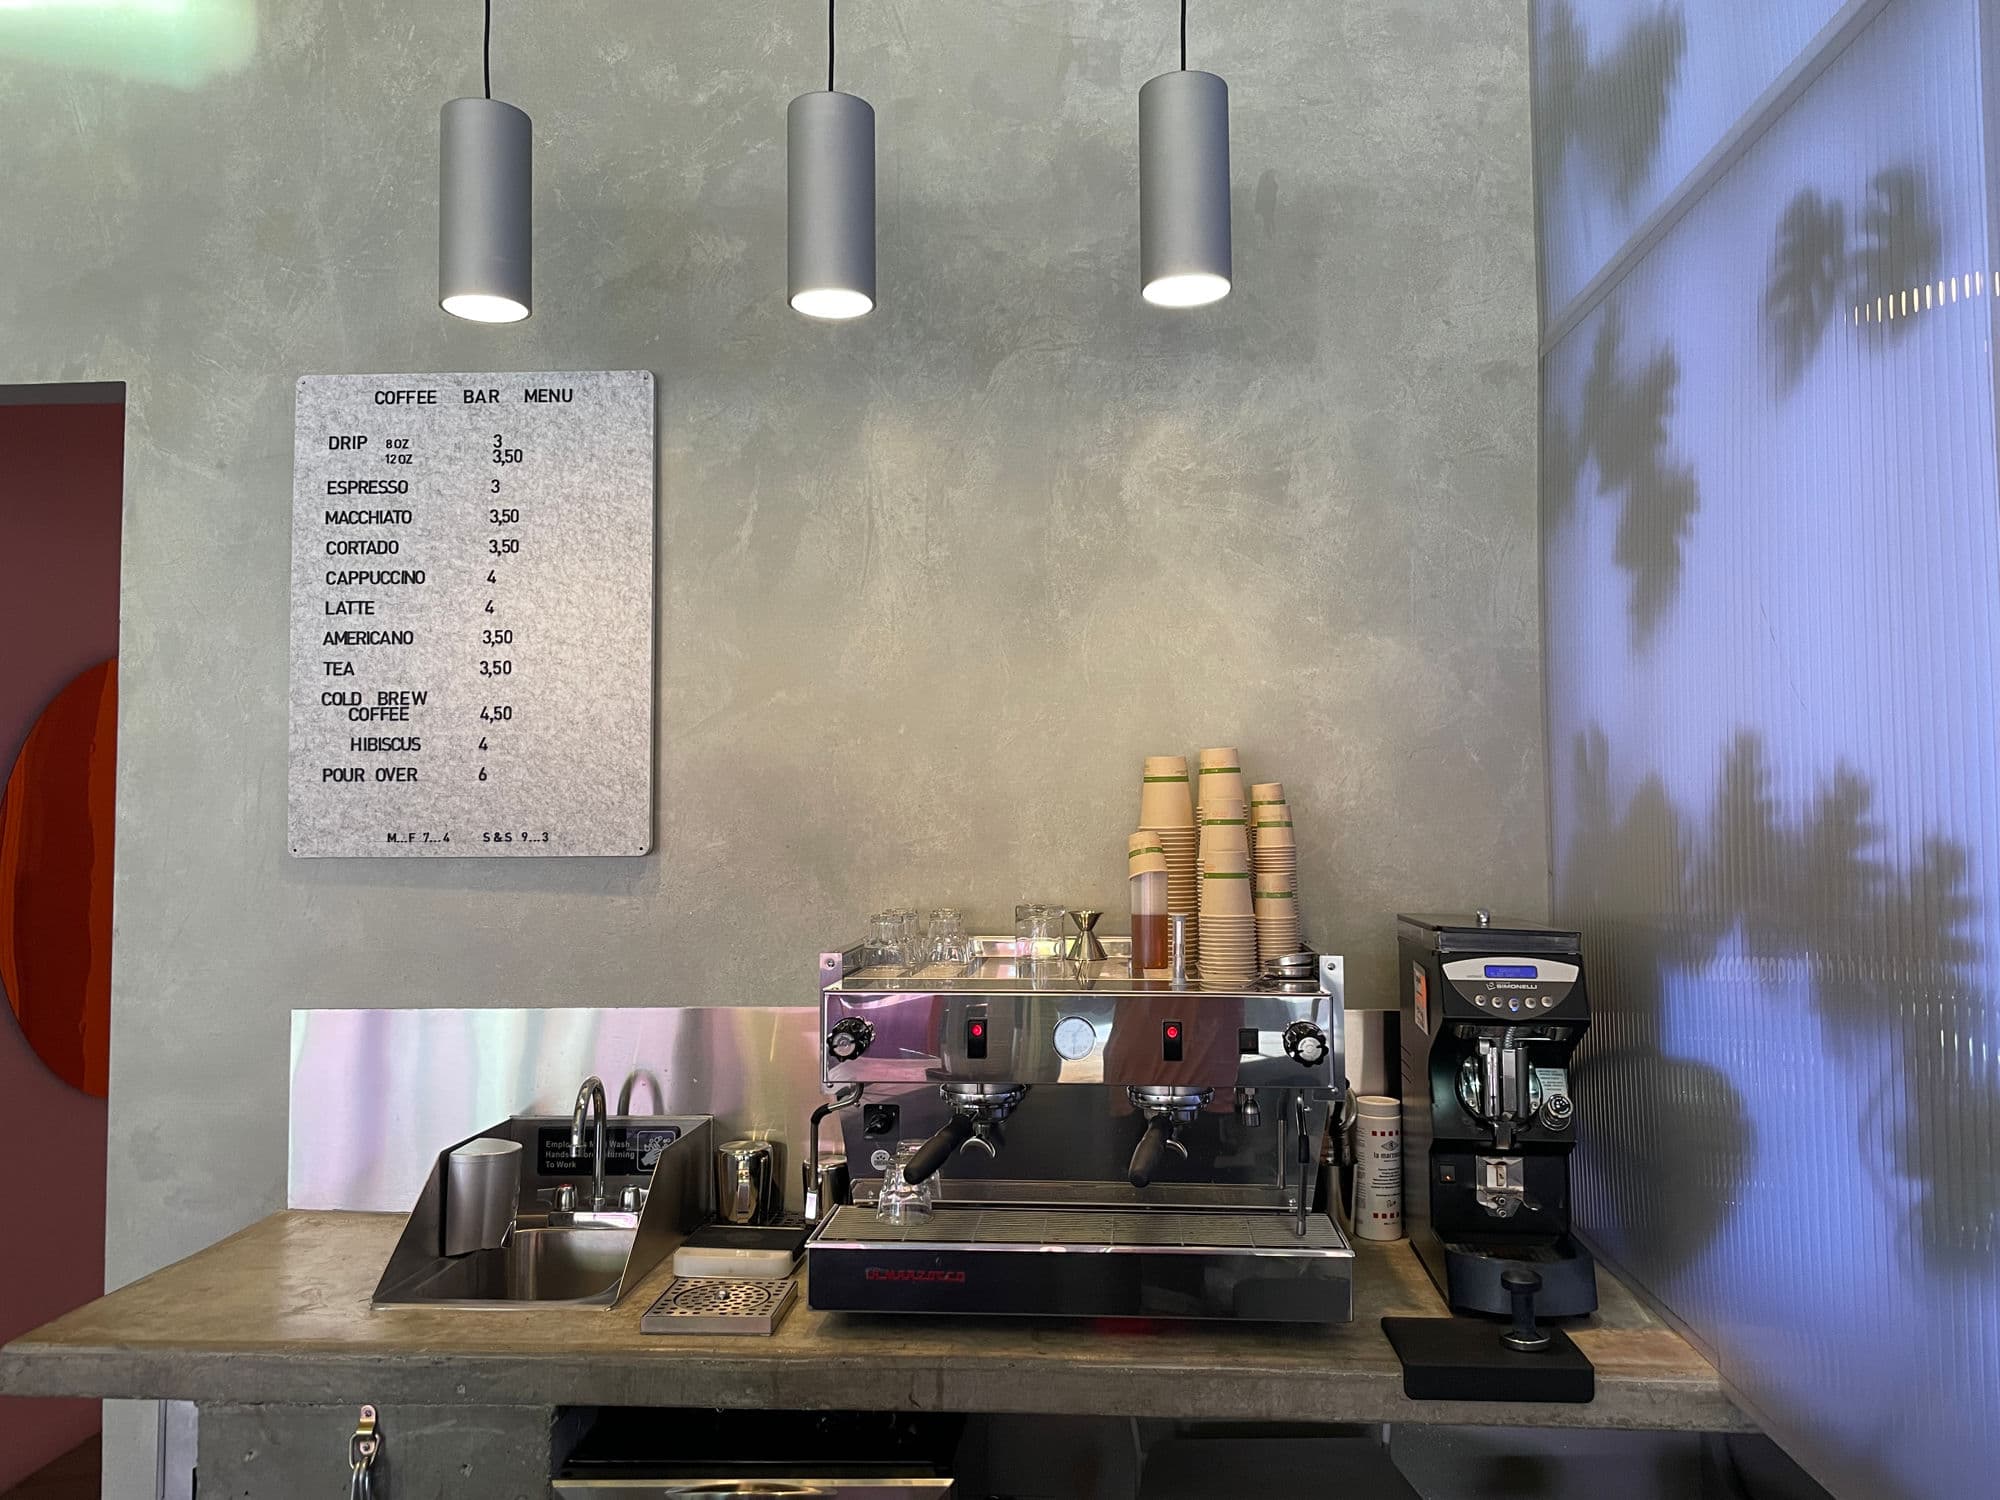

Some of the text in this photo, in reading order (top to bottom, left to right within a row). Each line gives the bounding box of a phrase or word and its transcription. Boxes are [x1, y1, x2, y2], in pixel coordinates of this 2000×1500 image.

[374, 388, 573, 405] COFFEE BAR MENU
[328, 435, 368, 450] DRIP
[492, 433, 503, 449] 3
[492, 449, 523, 467] 3,50
[327, 478, 500, 495] ESPRESSO 3
[325, 508, 520, 527] MACCHIATO 3,50
[326, 538, 520, 557] CORTADO 3,50
[325, 569, 497, 586] CAPPUCCINO 4
[325, 599, 495, 616] LATTE 4
[322, 629, 513, 648] AMERICANO 3,50
[322, 660, 512, 679] TEA 3,50
[321, 690, 428, 707] COLD BREW
[348, 705, 513, 724] COFFEE 4,50
[350, 736, 489, 752] HIBISCUS 4
[322, 766, 488, 783] POUR OVER 6
[609, 1140, 630, 1148] Wash
[545, 1150, 569, 1158] Hands
